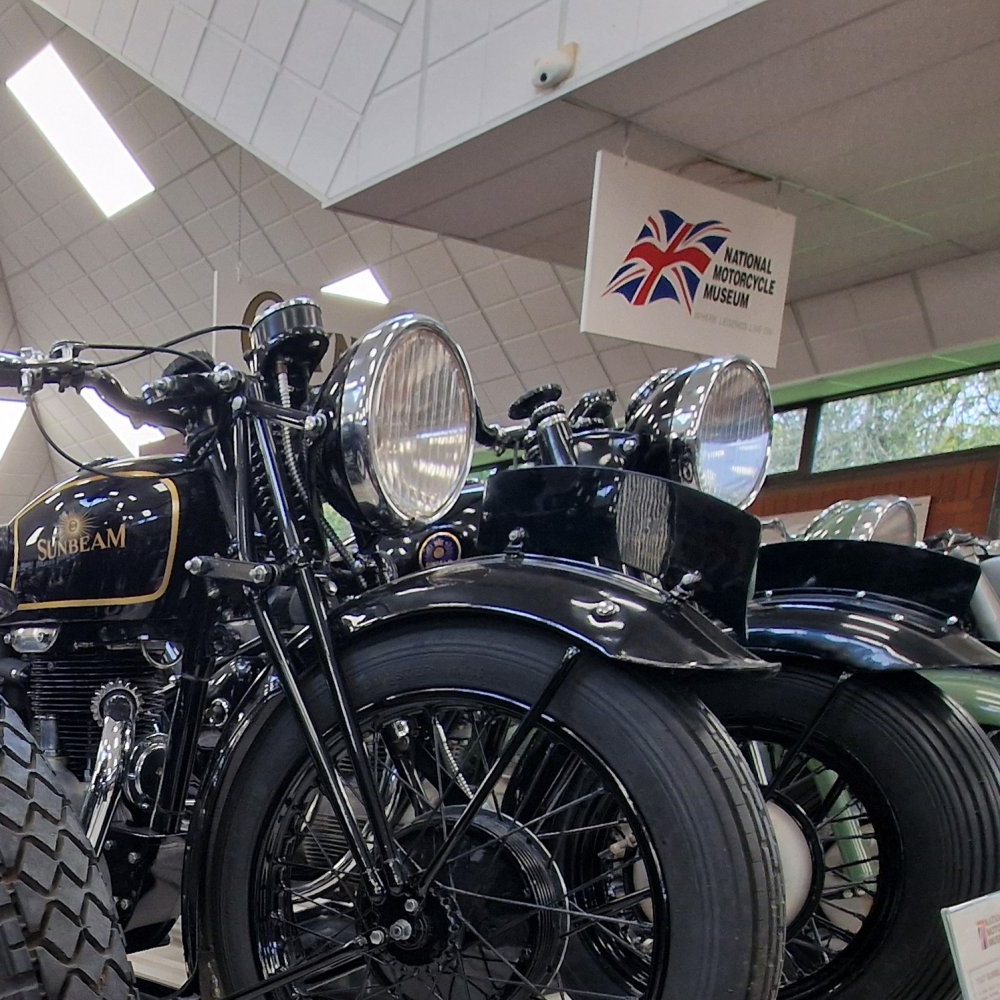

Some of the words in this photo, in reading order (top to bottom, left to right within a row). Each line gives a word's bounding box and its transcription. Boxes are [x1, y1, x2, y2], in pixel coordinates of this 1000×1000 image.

[724, 246, 772, 275] NATIONAL
[713, 264, 776, 295] MOTORCYCLE
[703, 283, 749, 309] MUSEUM
[37, 523, 127, 561] SUNBEAM
